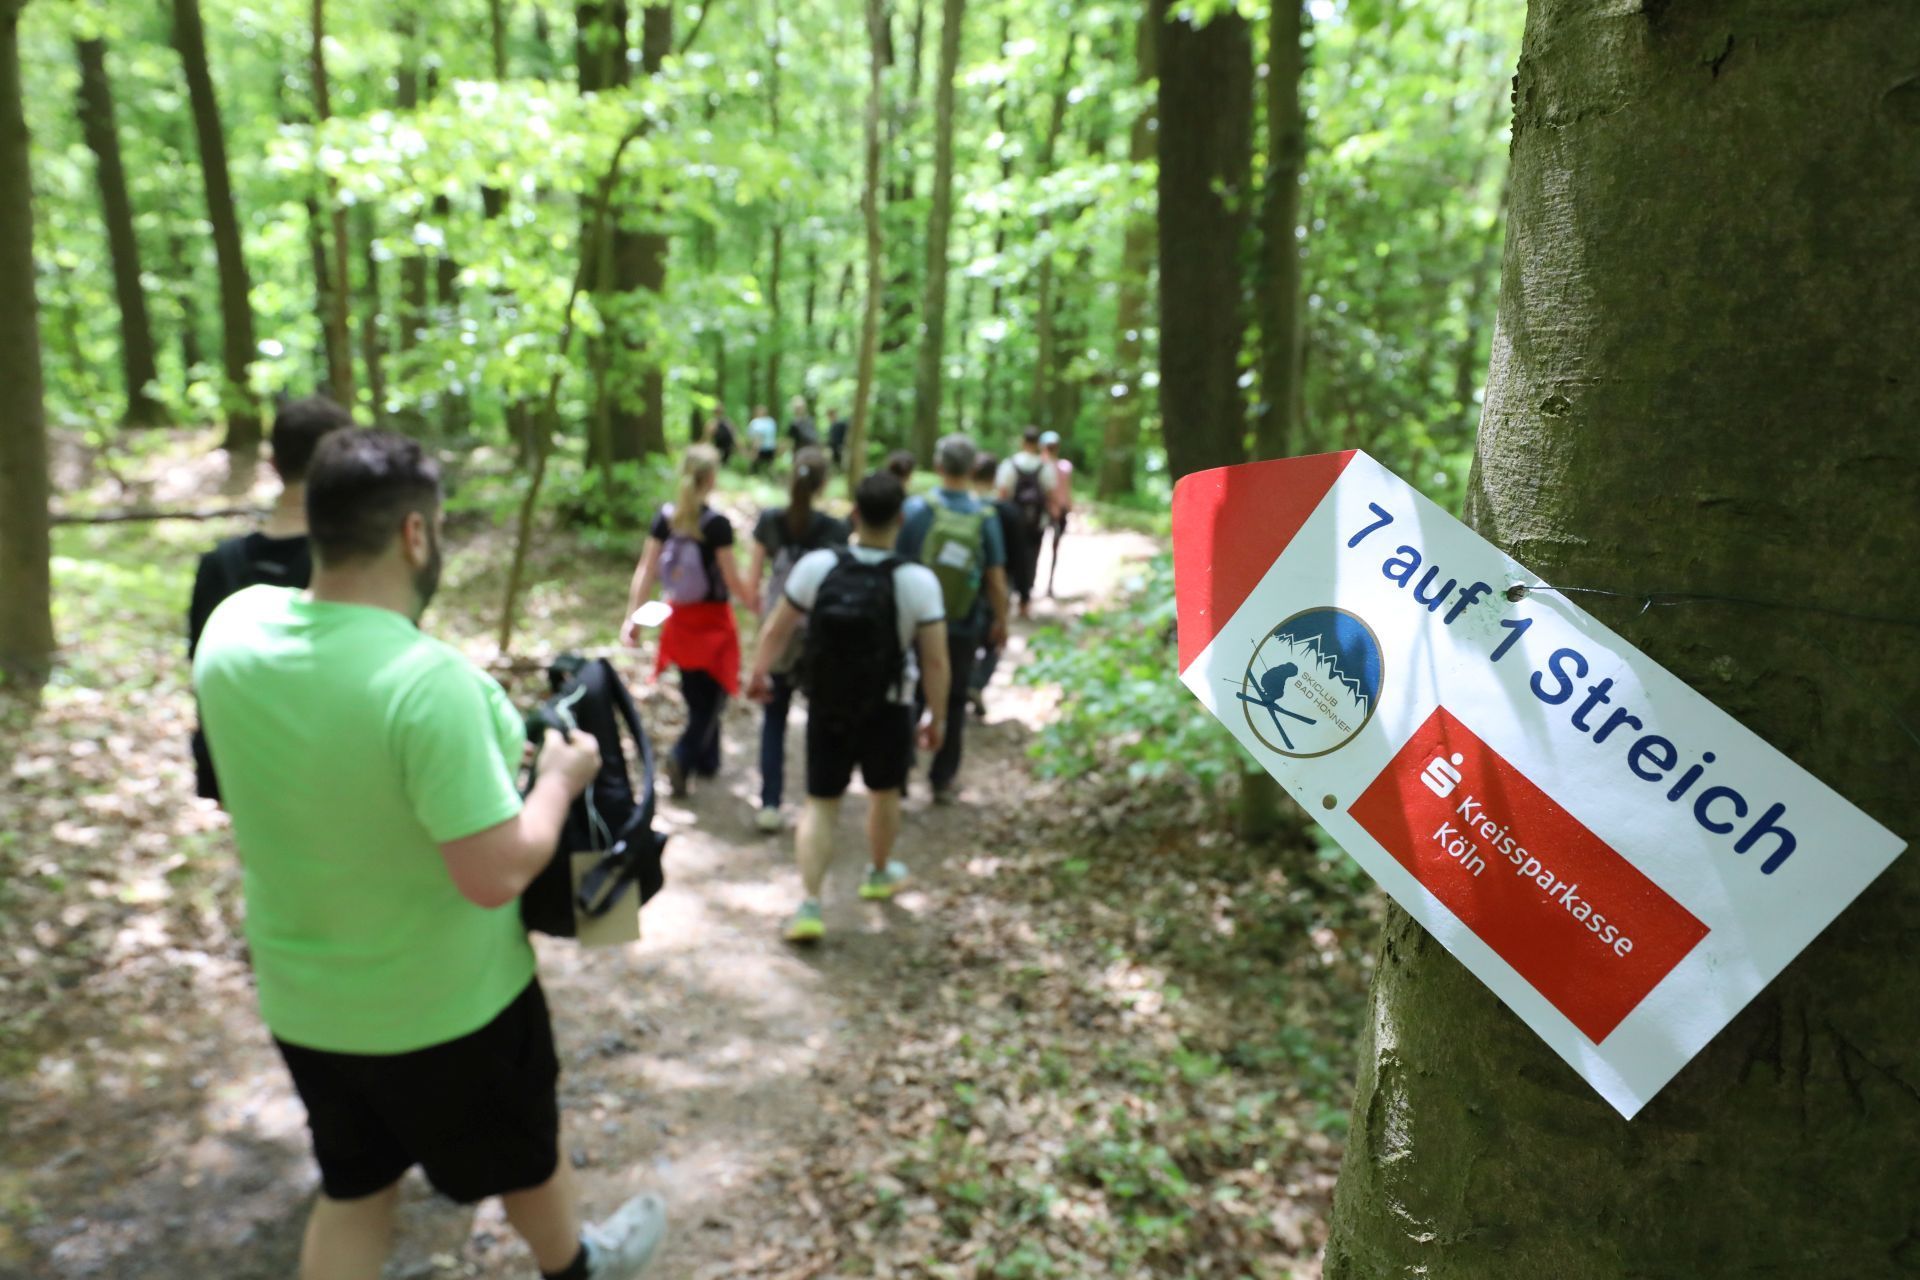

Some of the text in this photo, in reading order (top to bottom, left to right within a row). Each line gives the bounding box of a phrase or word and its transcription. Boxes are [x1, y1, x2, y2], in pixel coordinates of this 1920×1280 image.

[1294, 680, 1352, 733] BAD HONNEF
[1301, 671, 1338, 707] SKICLUB
[1347, 502, 1797, 875] 7 auf 1 Streich
[1432, 821, 1488, 877] Köln
[1456, 795, 1633, 957] Kreissparkasse
